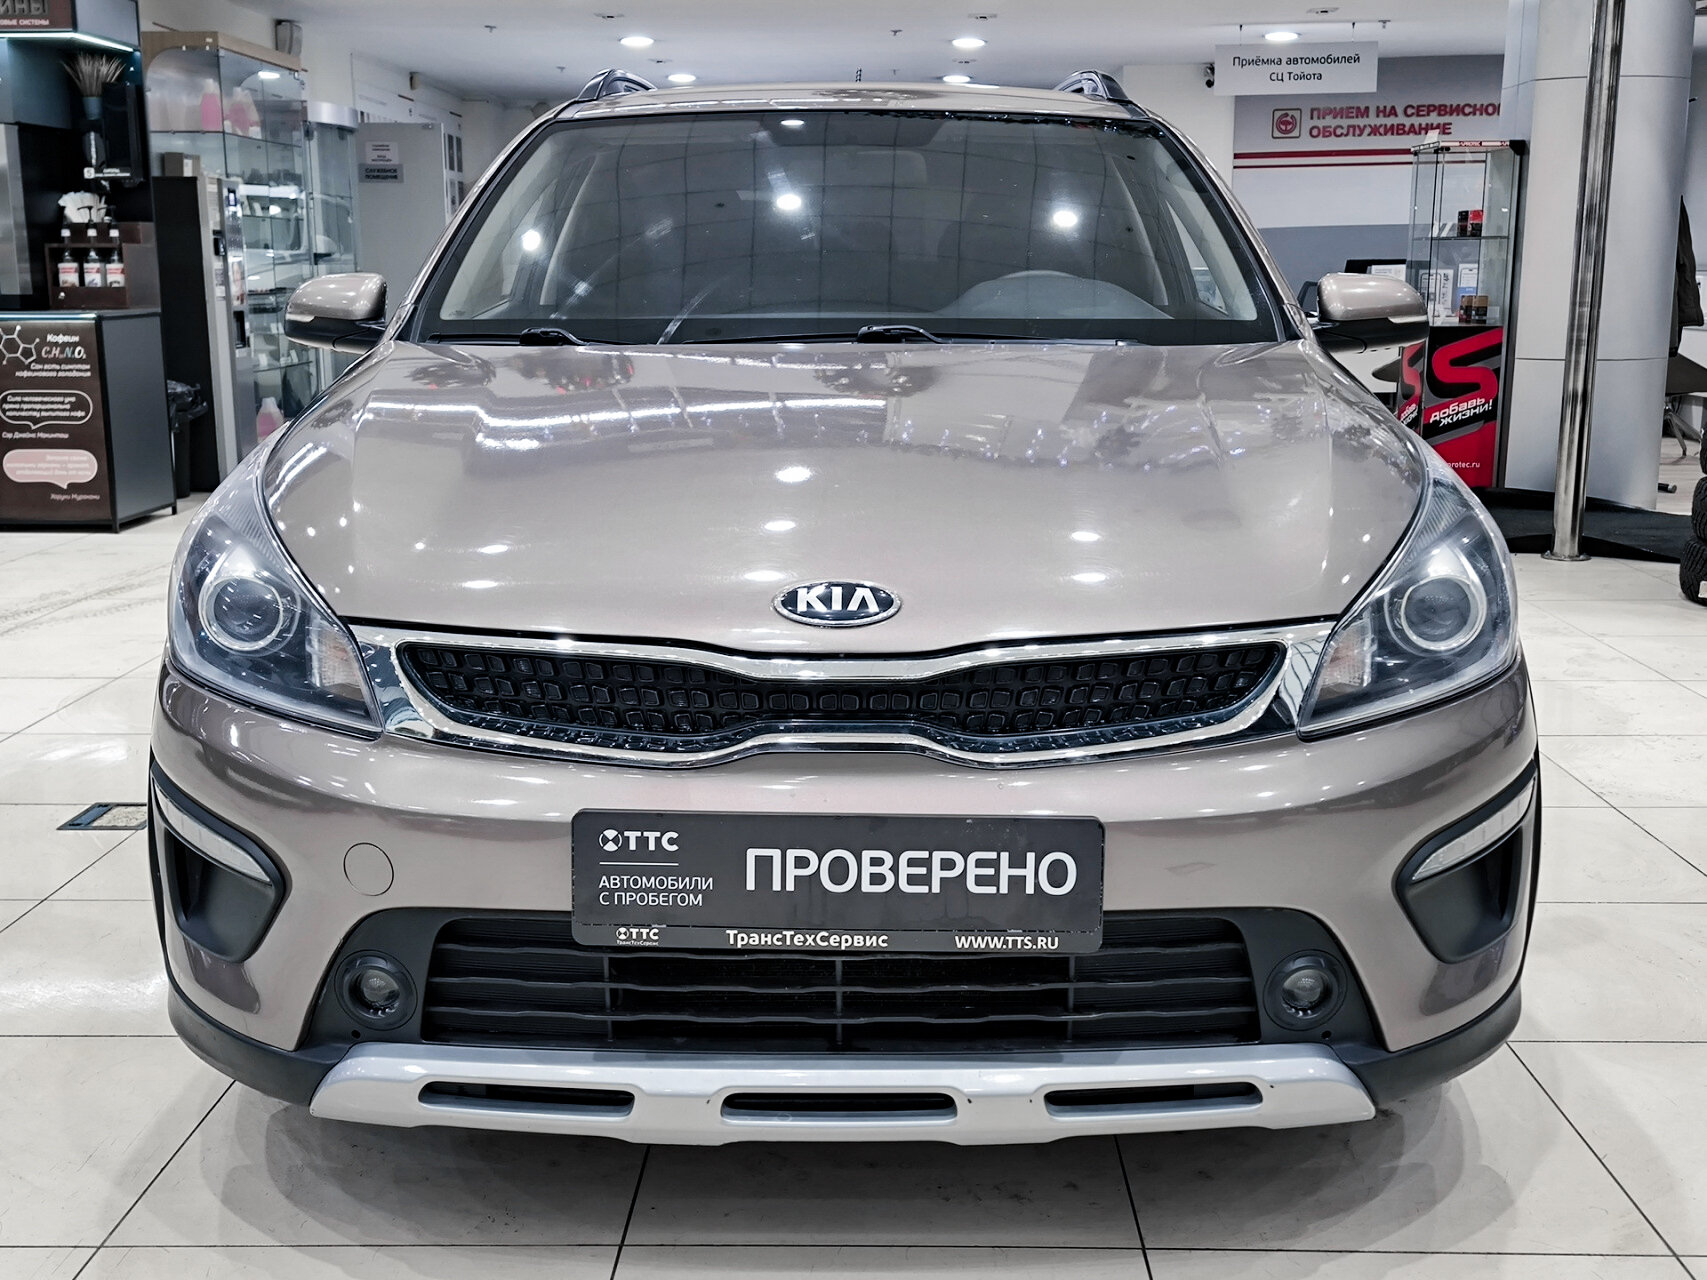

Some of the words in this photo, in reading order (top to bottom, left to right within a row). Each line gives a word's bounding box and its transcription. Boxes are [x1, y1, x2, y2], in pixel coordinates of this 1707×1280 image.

[1232, 56, 1283, 68] Приёмка
[1285, 53, 1361, 65] автомобилей
[1269, 71, 1285, 82] СЦ
[1287, 71, 1323, 81] Тойота
[1310, 106, 1370, 120] ПРИЕМ
[1376, 104, 1399, 118] НА
[1403, 102, 1501, 118] СЕРВИСНО
[1309, 122, 1453, 139] ОБСЛУЖИВАНИЕ
[1430, 398, 1486, 424] добавь
[1439, 399, 1493, 427] жизни!
[796, 584, 880, 613] KIA
[623, 831, 680, 852] ТТС
[746, 848, 1077, 895] ПРОВЕРЕНО
[599, 875, 714, 890] АВТОМОБИЛИ
[599, 892, 610, 905] С
[614, 892, 703, 907] ПРОБЕГОМ
[630, 928, 660, 940] ТТС
[725, 929, 889, 948] ТрансТехСервис
[955, 935, 1060, 950] WWW.TTS.RU
